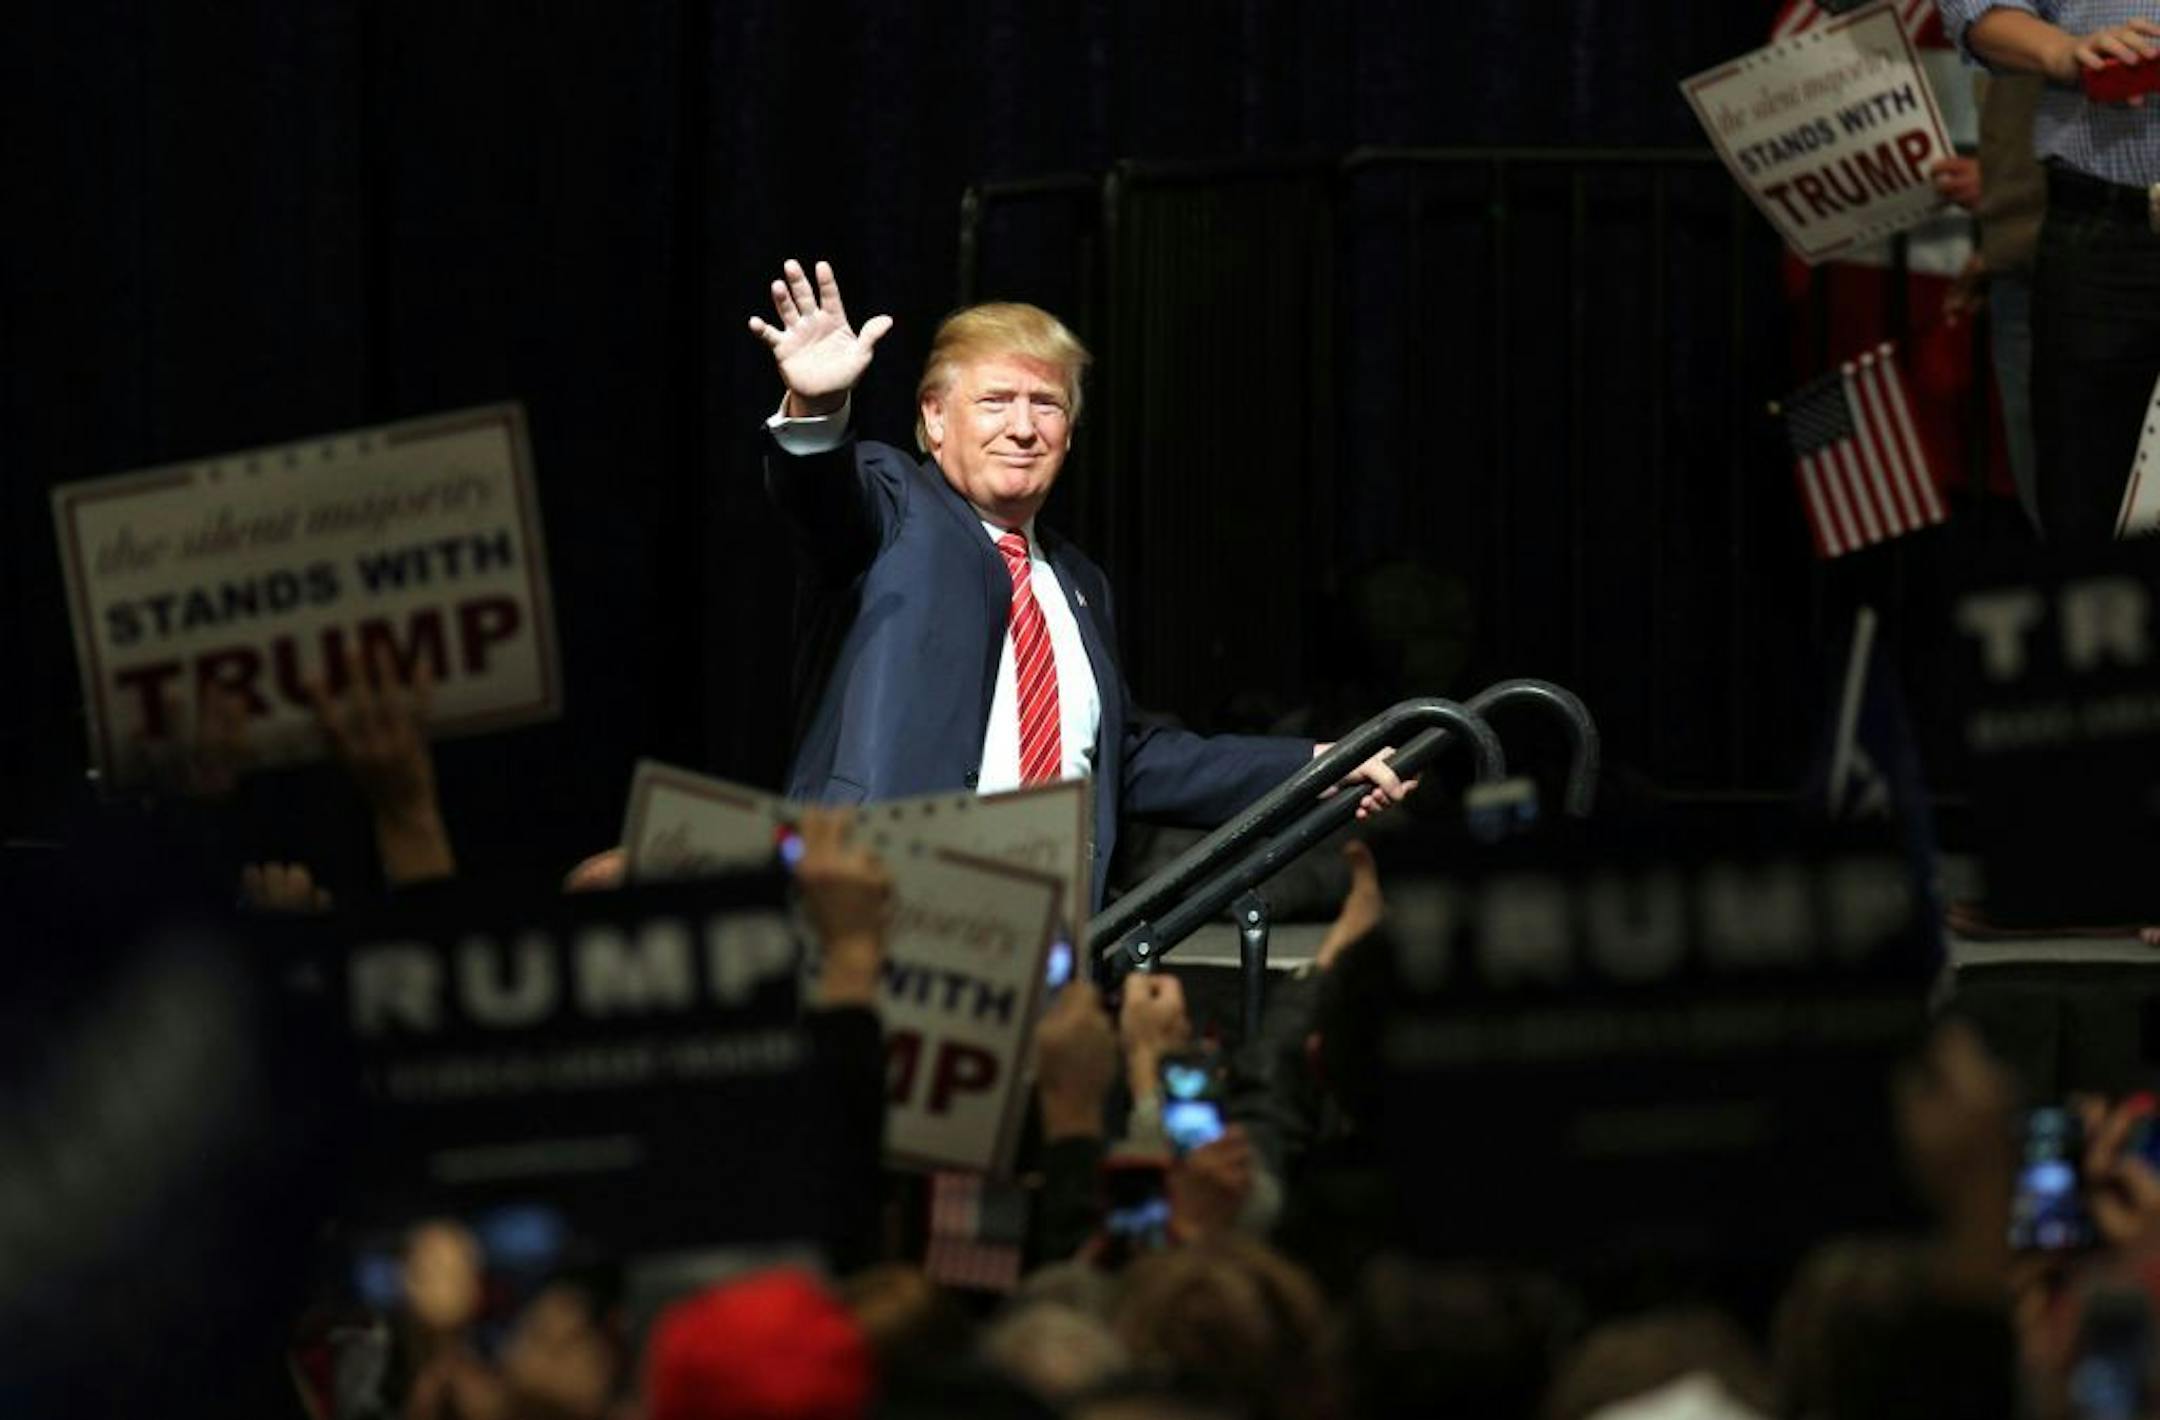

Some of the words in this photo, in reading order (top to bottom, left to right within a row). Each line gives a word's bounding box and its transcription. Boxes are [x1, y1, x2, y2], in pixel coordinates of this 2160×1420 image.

[1737, 117, 1836, 174] STANDS
[1836, 82, 1918, 136] WITH
[1763, 128, 1932, 227] TRUMP
[94, 524, 163, 576] the
[107, 563, 338, 645] STANDS
[358, 531, 513, 590] WITH
[117, 599, 519, 740] TRUMP
[288, 907, 798, 1039] RUMP
